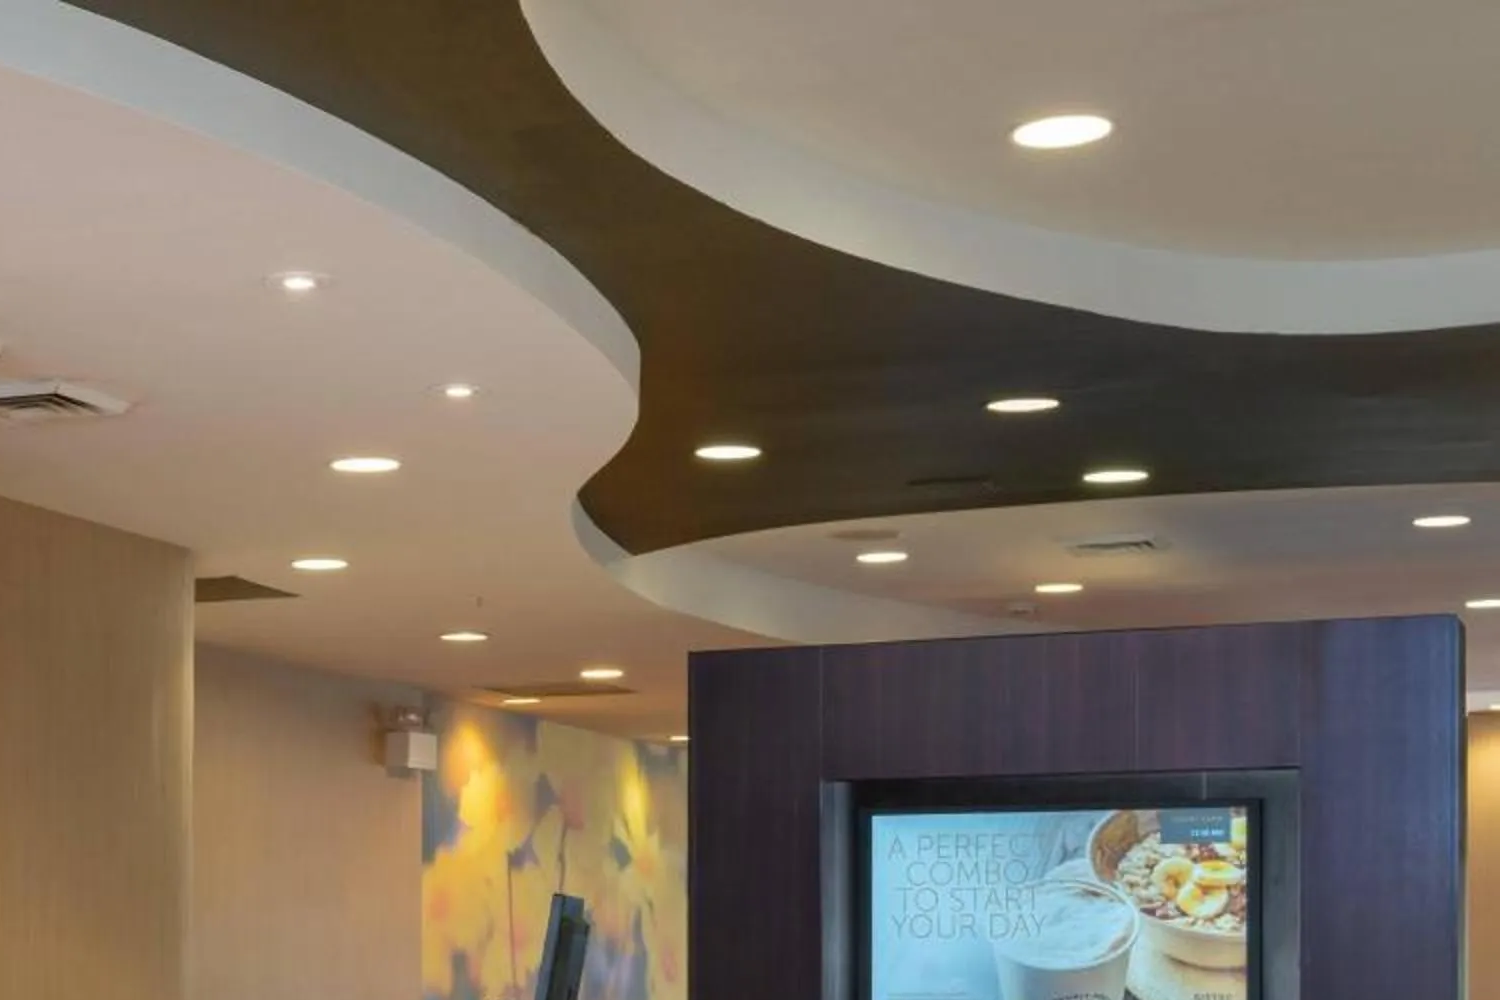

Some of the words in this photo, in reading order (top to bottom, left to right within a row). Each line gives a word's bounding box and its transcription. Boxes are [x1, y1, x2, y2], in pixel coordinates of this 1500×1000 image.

[888, 834, 906, 860] A
[916, 832, 1046, 859] PERFECT
[906, 859, 1029, 886] COMBO
[893, 886, 939, 913] TO
[949, 885, 1040, 913] START
[891, 912, 979, 940] YOUR
[989, 912, 1047, 940] DAY
